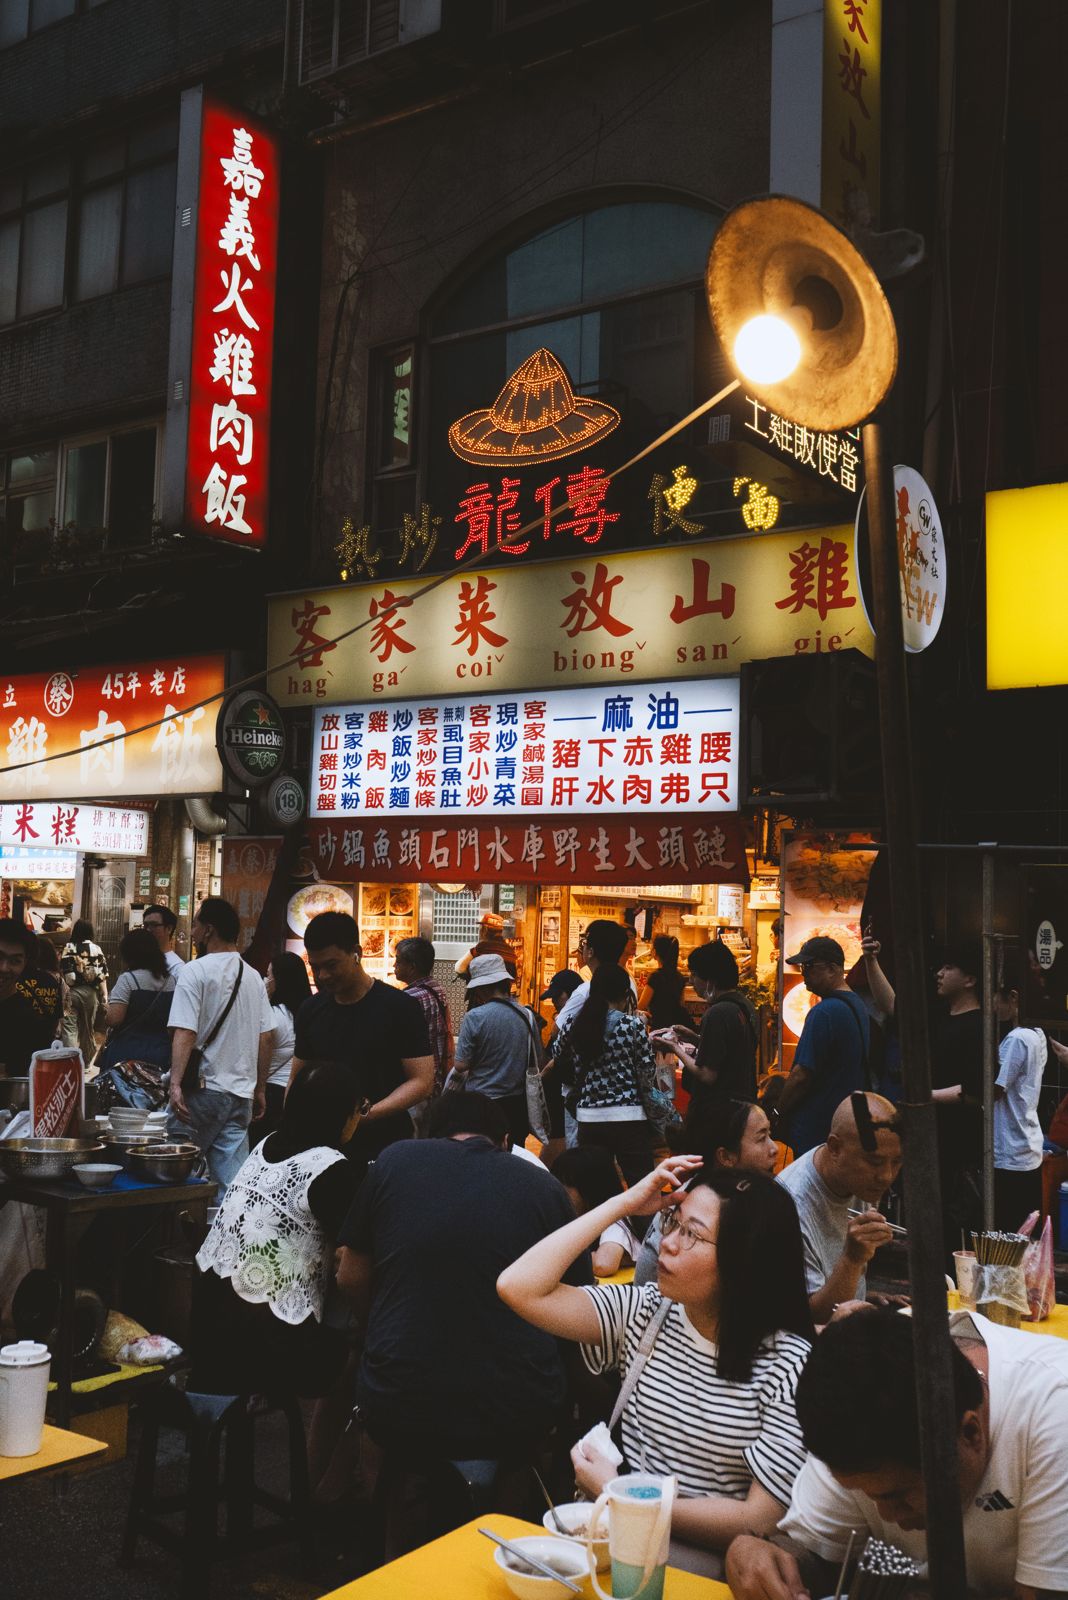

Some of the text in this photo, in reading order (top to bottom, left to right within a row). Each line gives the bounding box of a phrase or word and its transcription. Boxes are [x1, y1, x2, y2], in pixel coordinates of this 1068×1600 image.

[202, 127, 265, 535] 嘉義火雞肉飯
[286, 536, 858, 671] 客家菜放山雞
[101, 666, 187, 700] 45年老店
[602, 691, 680, 732] 麻油
[281, 793, 297, 809] 18
[316, 713, 340, 812] 放山雞切盤
[340, 711, 365, 810] 客家炒米粉
[364, 709, 389, 810] 雞肉飯
[388, 708, 414, 810] 炒飯炒麵
[415, 706, 440, 809] 客家炒板條
[465, 703, 493, 808] 客家小炒
[493, 701, 520, 807] 現炒青菜
[520, 700, 547, 807] 客家鹹湯圓
[12, 803, 81, 846] 米糕
